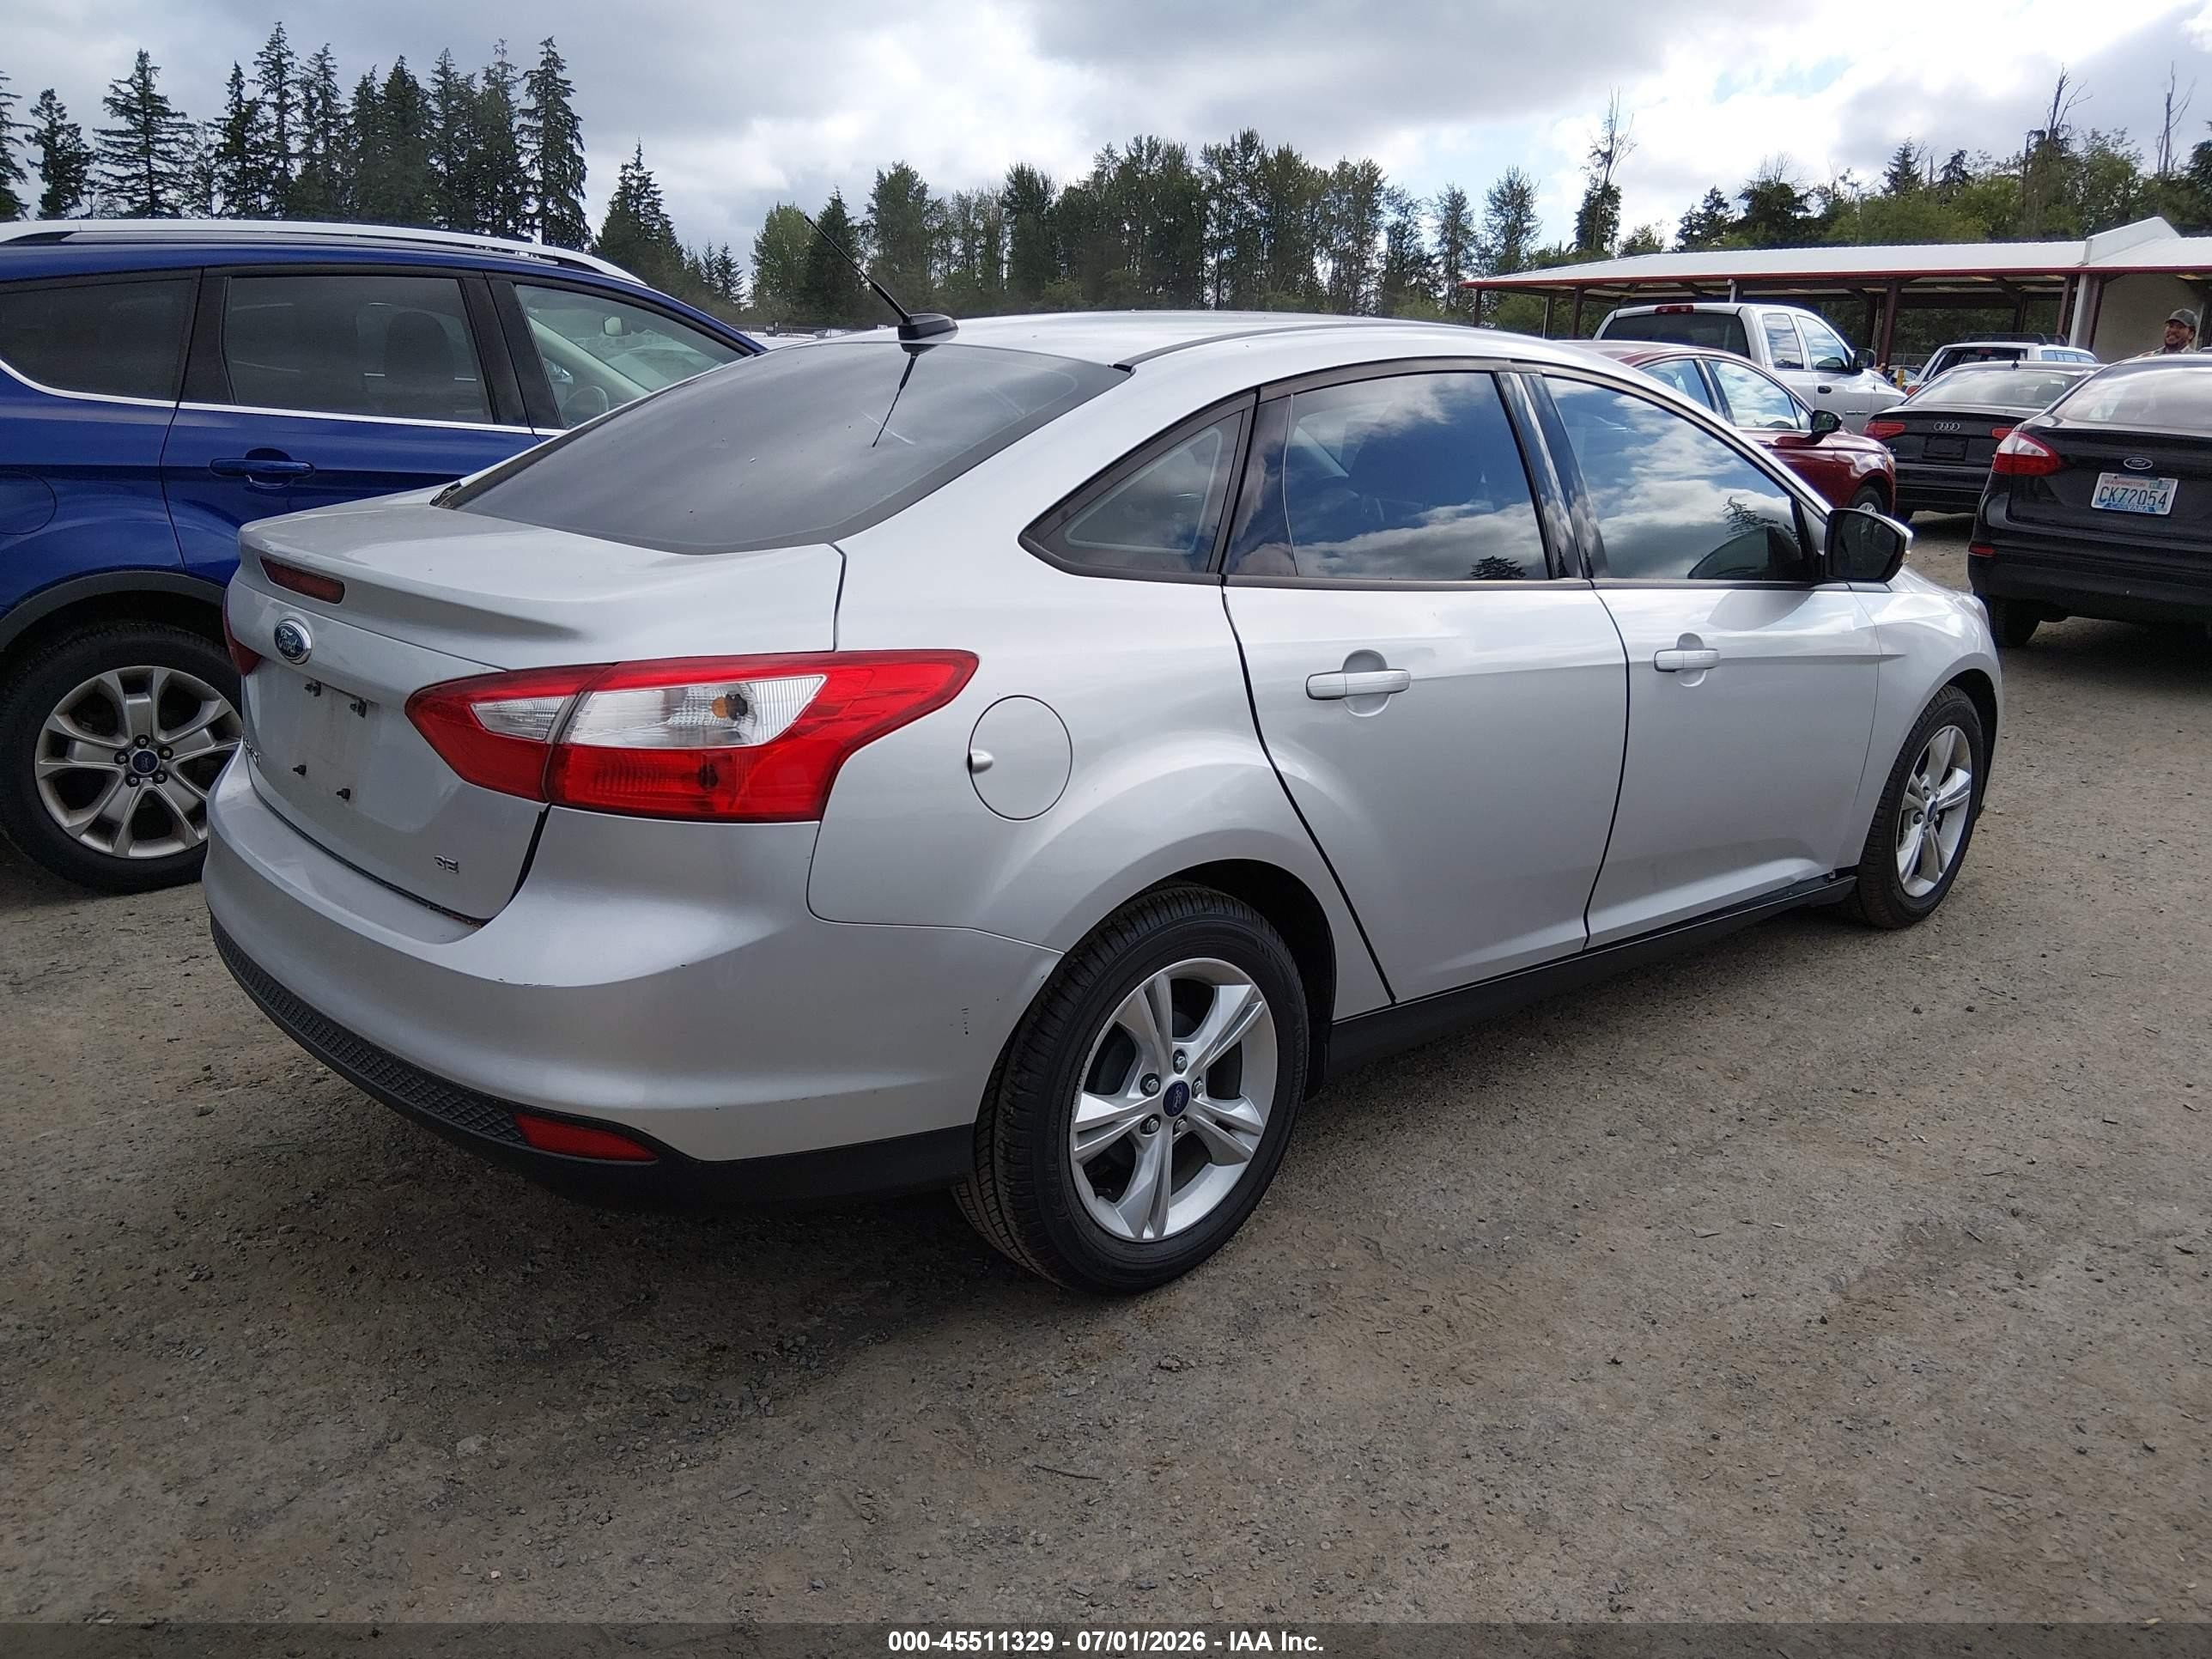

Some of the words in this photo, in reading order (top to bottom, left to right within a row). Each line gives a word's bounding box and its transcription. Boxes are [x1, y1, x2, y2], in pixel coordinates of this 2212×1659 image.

[2098, 486, 2169, 509] CK72054
[278, 628, 298, 653] Ford
[434, 854, 459, 873] SE
